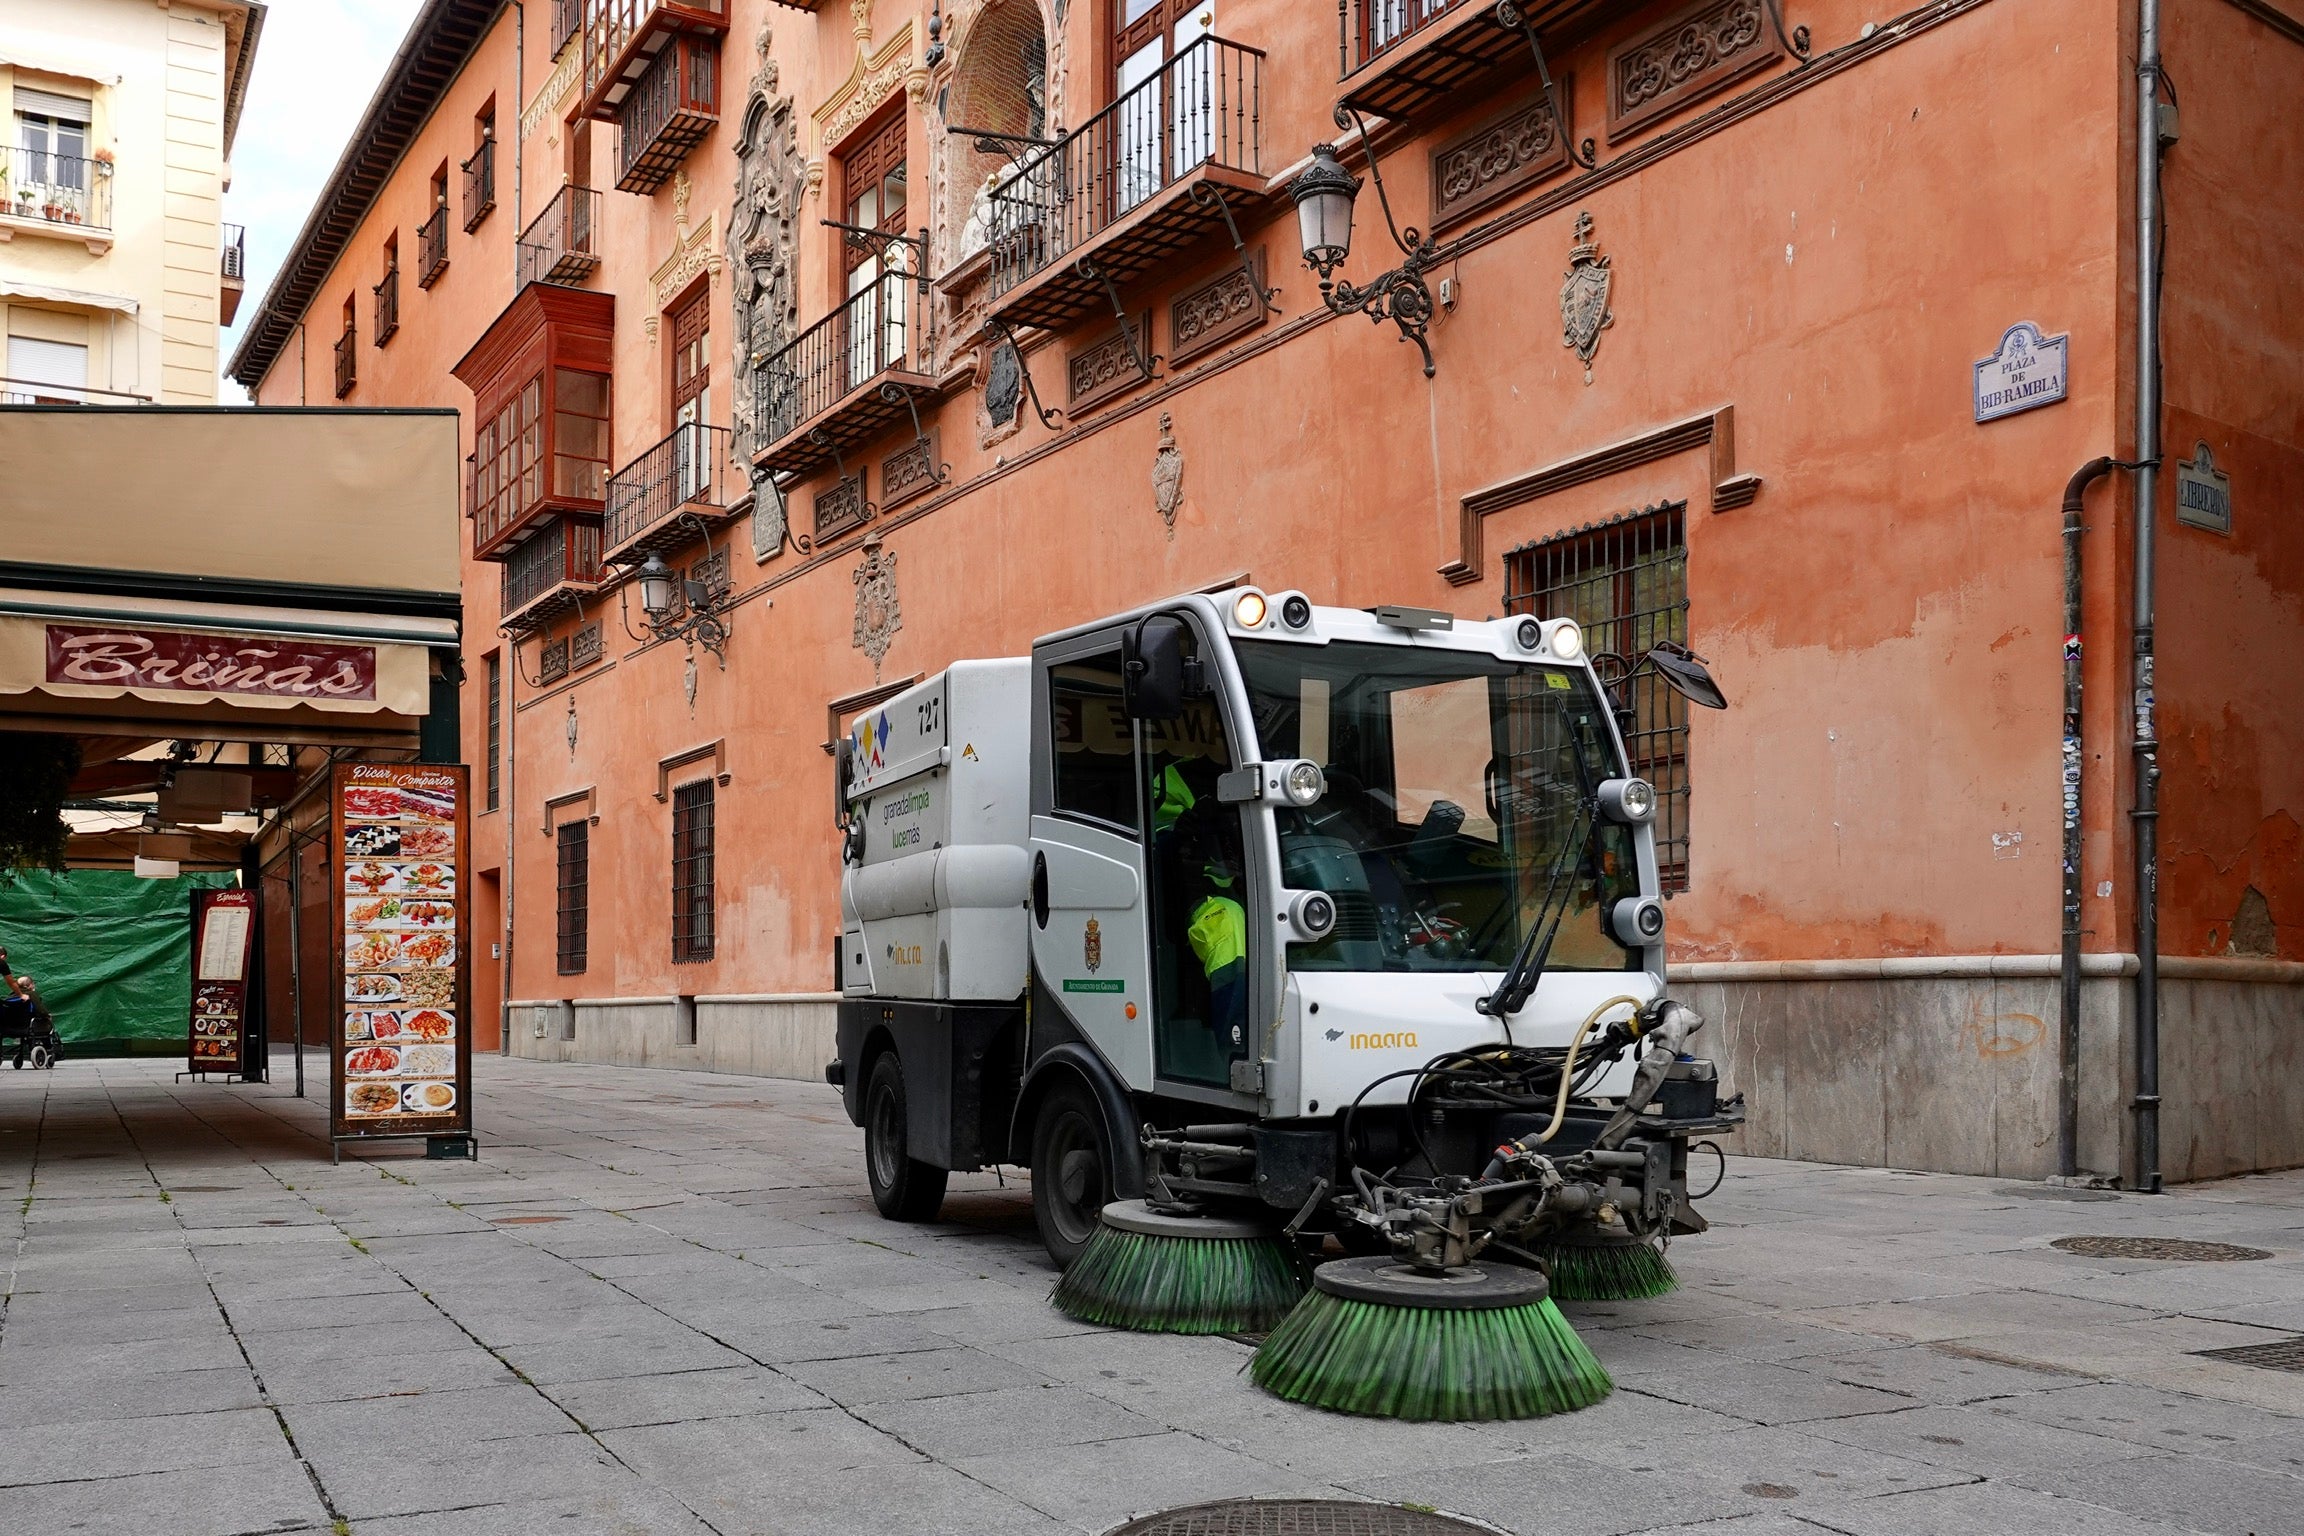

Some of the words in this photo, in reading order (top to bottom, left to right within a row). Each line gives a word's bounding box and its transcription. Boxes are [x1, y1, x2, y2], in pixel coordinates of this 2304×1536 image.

[2002, 355, 2036, 375] PLAZA
[2010, 371, 2026, 384] DE
[1981, 375, 2060, 410] BIB-RAMBLA
[2181, 479, 2226, 517] LIBREROS
[61, 634, 363, 694] Briñas
[918, 697, 939, 736] 727
[353, 765, 392, 779] Picar
[397, 774, 456, 787] Compartir
[883, 787, 930, 826] granadalimpia
[892, 822, 921, 849] lucemás
